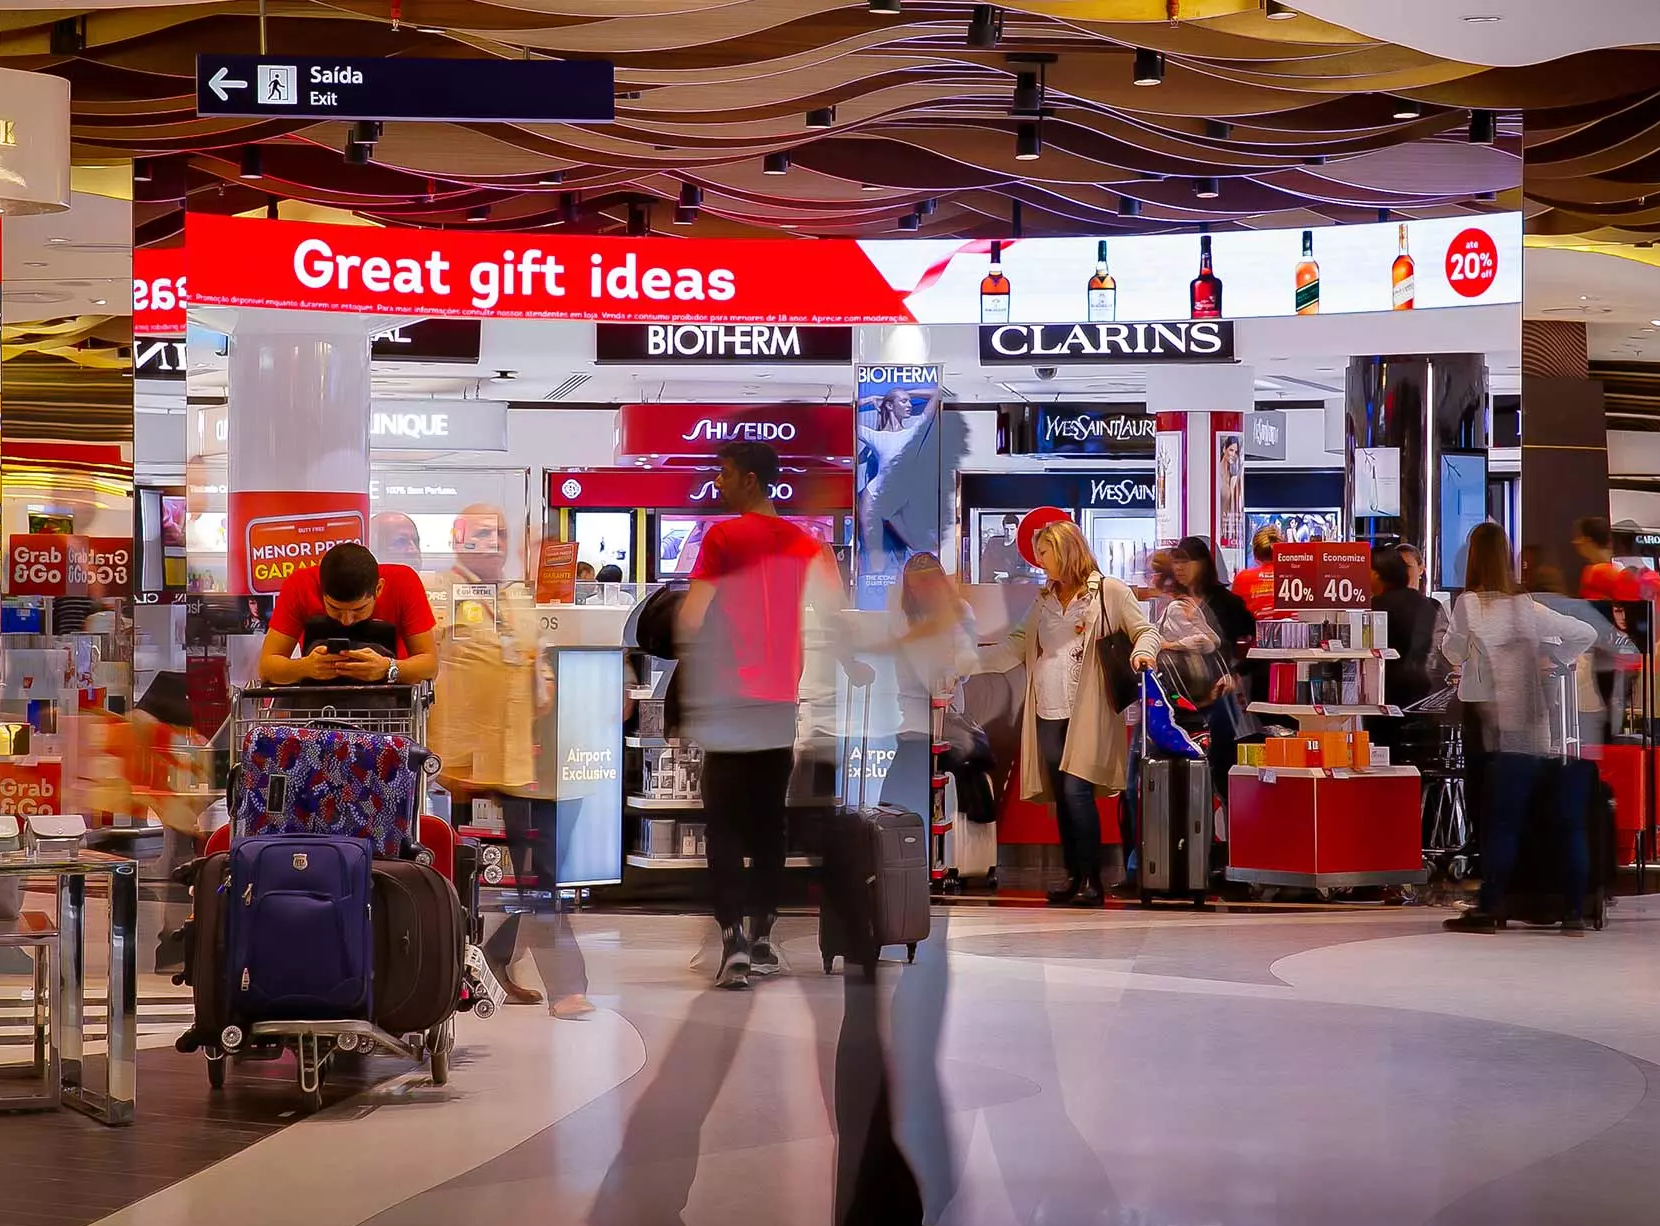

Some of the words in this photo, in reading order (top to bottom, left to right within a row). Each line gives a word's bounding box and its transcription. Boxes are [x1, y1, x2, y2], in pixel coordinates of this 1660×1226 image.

[310, 65, 363, 84] Saída
[310, 91, 338, 106] Exit
[293, 239, 450, 295] Great
[470, 249, 565, 308] gift
[590, 253, 736, 300] ideas
[1450, 251, 1492, 280] 20%
[1480, 268, 1493, 279] off
[648, 325, 801, 355] BIOTHERM
[991, 323, 1222, 355] CLARINS
[858, 366, 937, 383] BIOTHERM
[370, 412, 448, 438] INIQUE
[682, 419, 796, 440] SHISEIDO
[14, 546, 62, 564] Grab
[253, 542, 311, 560] MENOR
[1277, 552, 1314, 562] Economize
[1322, 552, 1366, 562] Economize
[14, 564, 62, 583] &Go
[1278, 578, 1314, 602] 40%
[1323, 578, 1366, 602] 40%
[567, 748, 611, 766] Airport
[850, 747, 896, 764] Arpo
[562, 766, 616, 780] Exclusive
[0, 778, 54, 797] Grab
[0, 798, 53, 819] &Go
